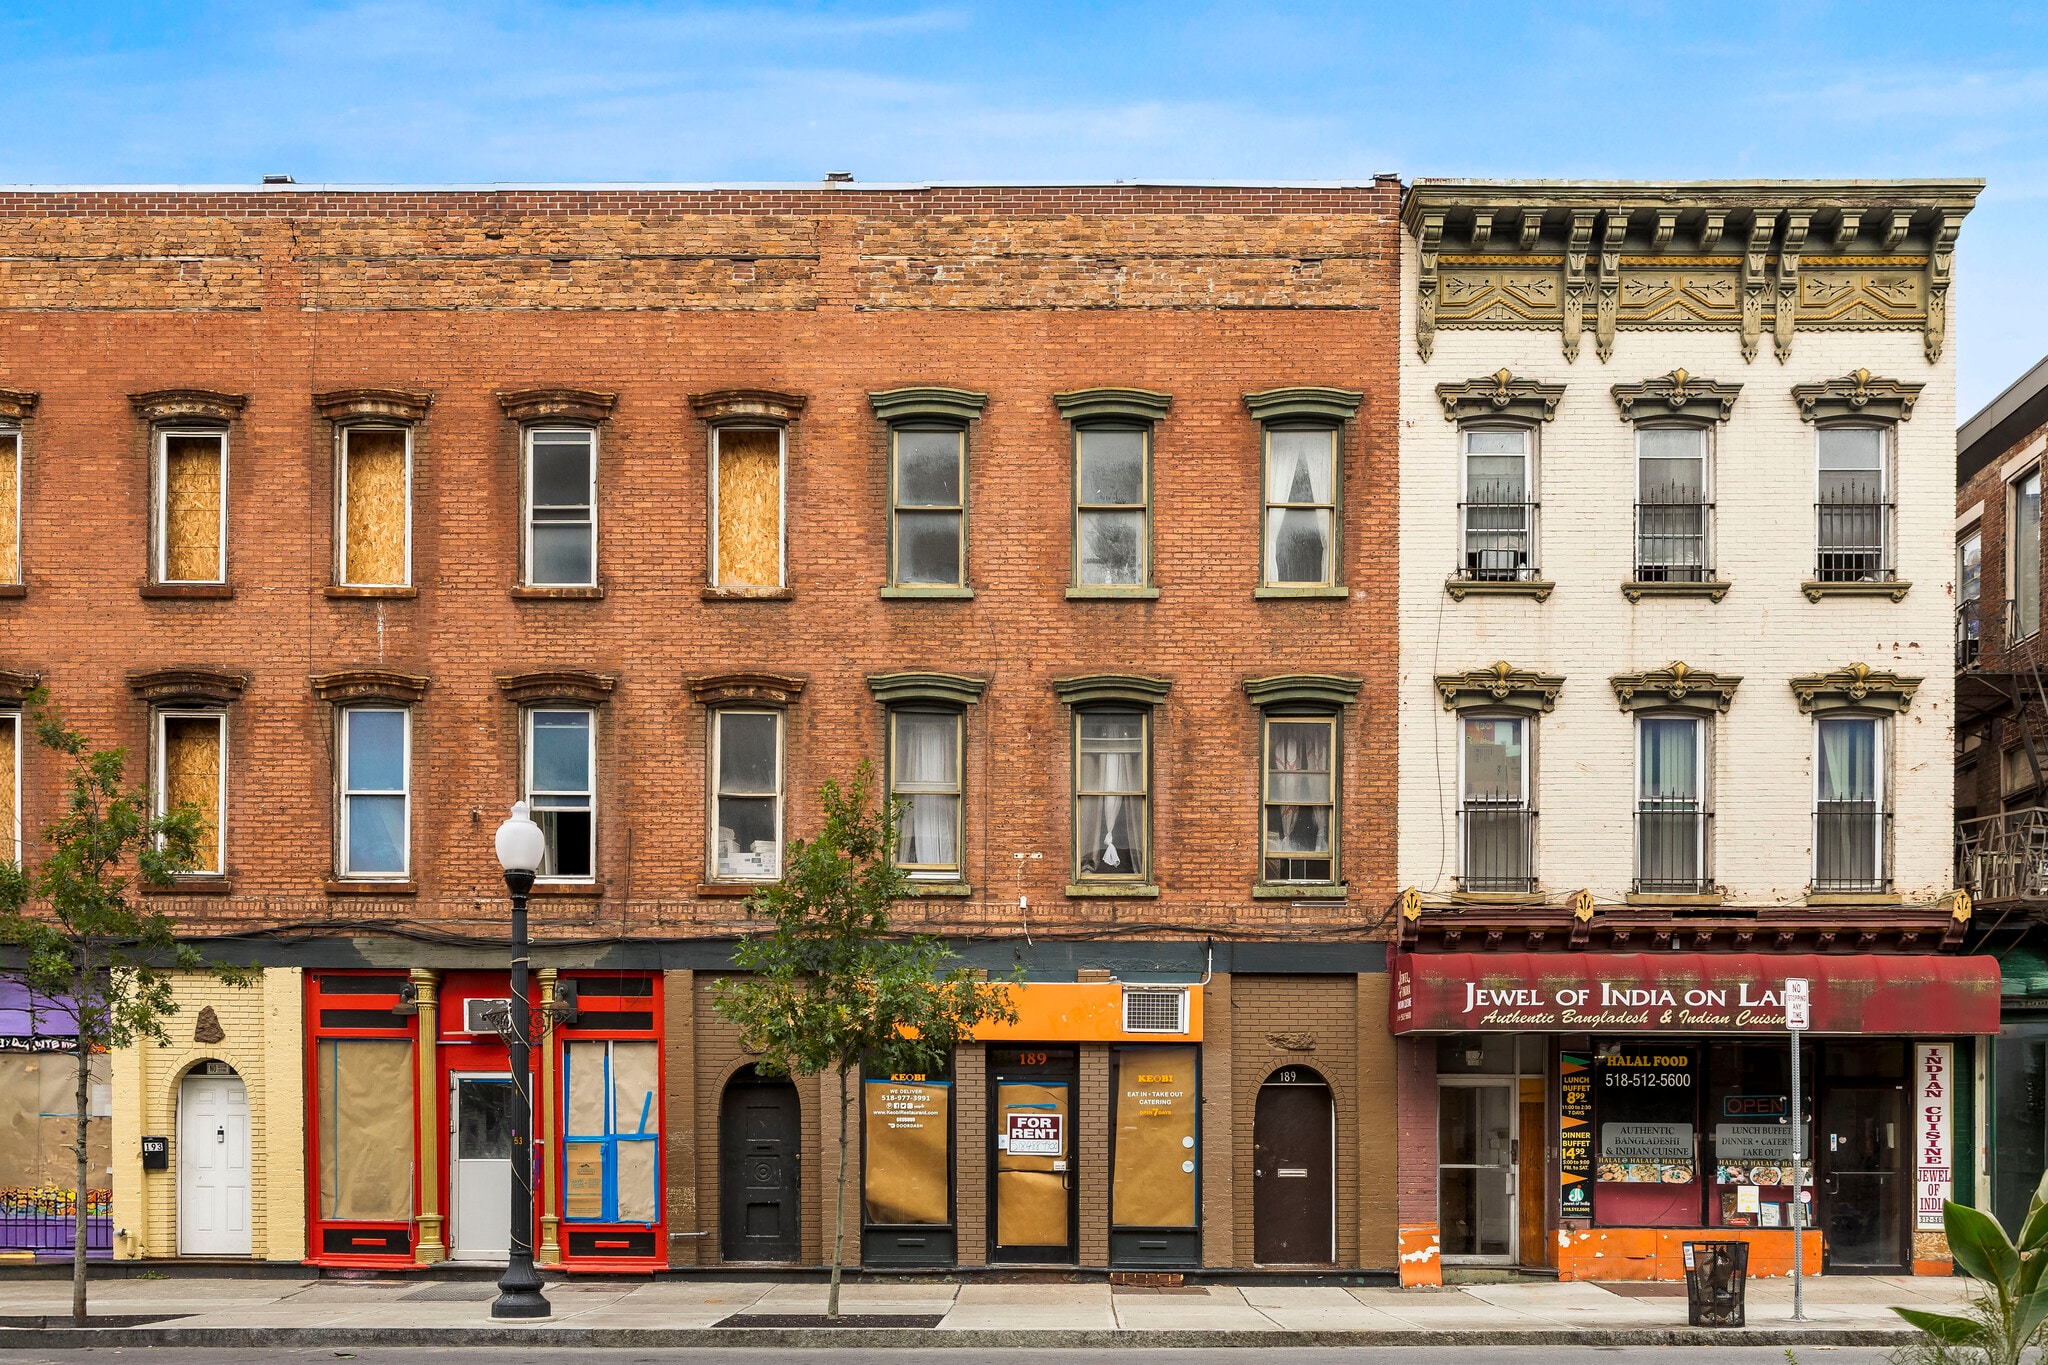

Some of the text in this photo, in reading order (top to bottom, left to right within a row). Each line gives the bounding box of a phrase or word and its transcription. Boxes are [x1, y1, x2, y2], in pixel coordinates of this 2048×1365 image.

[1792, 983, 1801, 993] NO
[1462, 982, 1812, 1013] JEWEL OF INDIA ON LA
[1481, 1009, 1787, 1028] Authentic Bangladesh & Indian Cuisin
[1020, 1052, 1047, 1065] 189
[1607, 1055, 1688, 1067] HALAL FOOD
[890, 1073, 926, 1081] KEOBI
[1280, 1071, 1296, 1082] 189
[1924, 1048, 1943, 1098] INDIAN
[1138, 1074, 1173, 1083] KEOBI
[1605, 1073, 1691, 1087] 518-512-5600
[881, 1094, 931, 1102] 518-977-3991
[1727, 1098, 1783, 1113] OPEN
[1152, 1108, 1159, 1116] 7
[1017, 1117, 1052, 1128] FOR
[1011, 1128, 1057, 1139] RENT
[1562, 1131, 1591, 1139] DINNER
[1620, 1126, 1675, 1135] AUTHENTIC
[1732, 1126, 1793, 1134] LUNCH BUFFET
[1615, 1136, 1680, 1145] BANGLADESHI
[1924, 1106, 1943, 1165] CUISINE
[1721, 1137, 1753, 1145] DINNER
[145, 1143, 163, 1151] 193
[1605, 1147, 1689, 1156] & INDIAN CUISINE
[1742, 1148, 1783, 1156] TAKE OUT
[1917, 1169, 1951, 1182] JEWEL
[1928, 1183, 1940, 1196] OF
